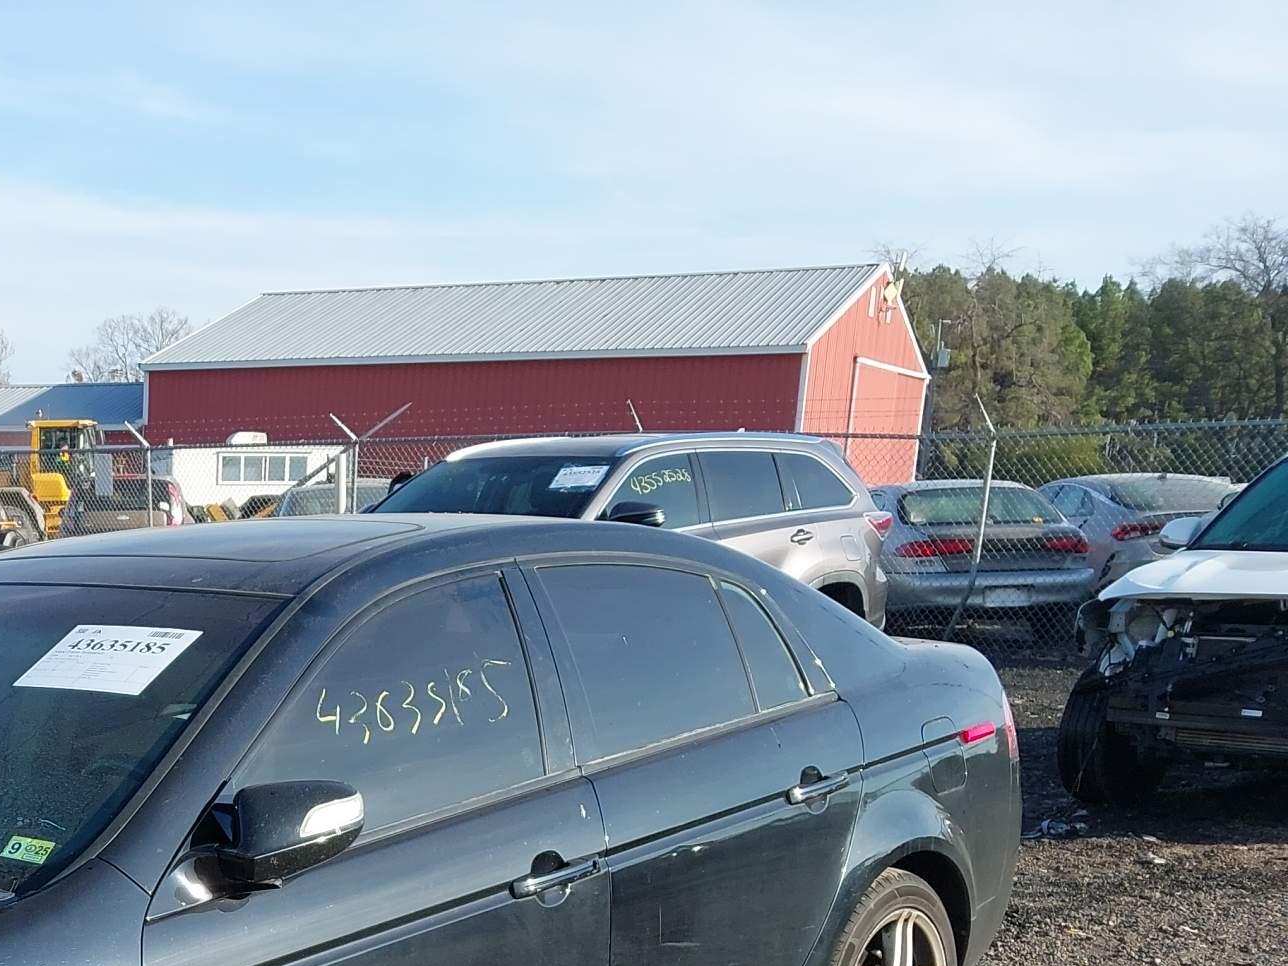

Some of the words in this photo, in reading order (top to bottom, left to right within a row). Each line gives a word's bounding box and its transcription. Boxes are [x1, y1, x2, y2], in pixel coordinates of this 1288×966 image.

[67, 638, 172, 654] 43635185
[316, 659, 511, 744] 43635185
[8, 842, 22, 854] 9
[34, 845, 50, 856] 25
